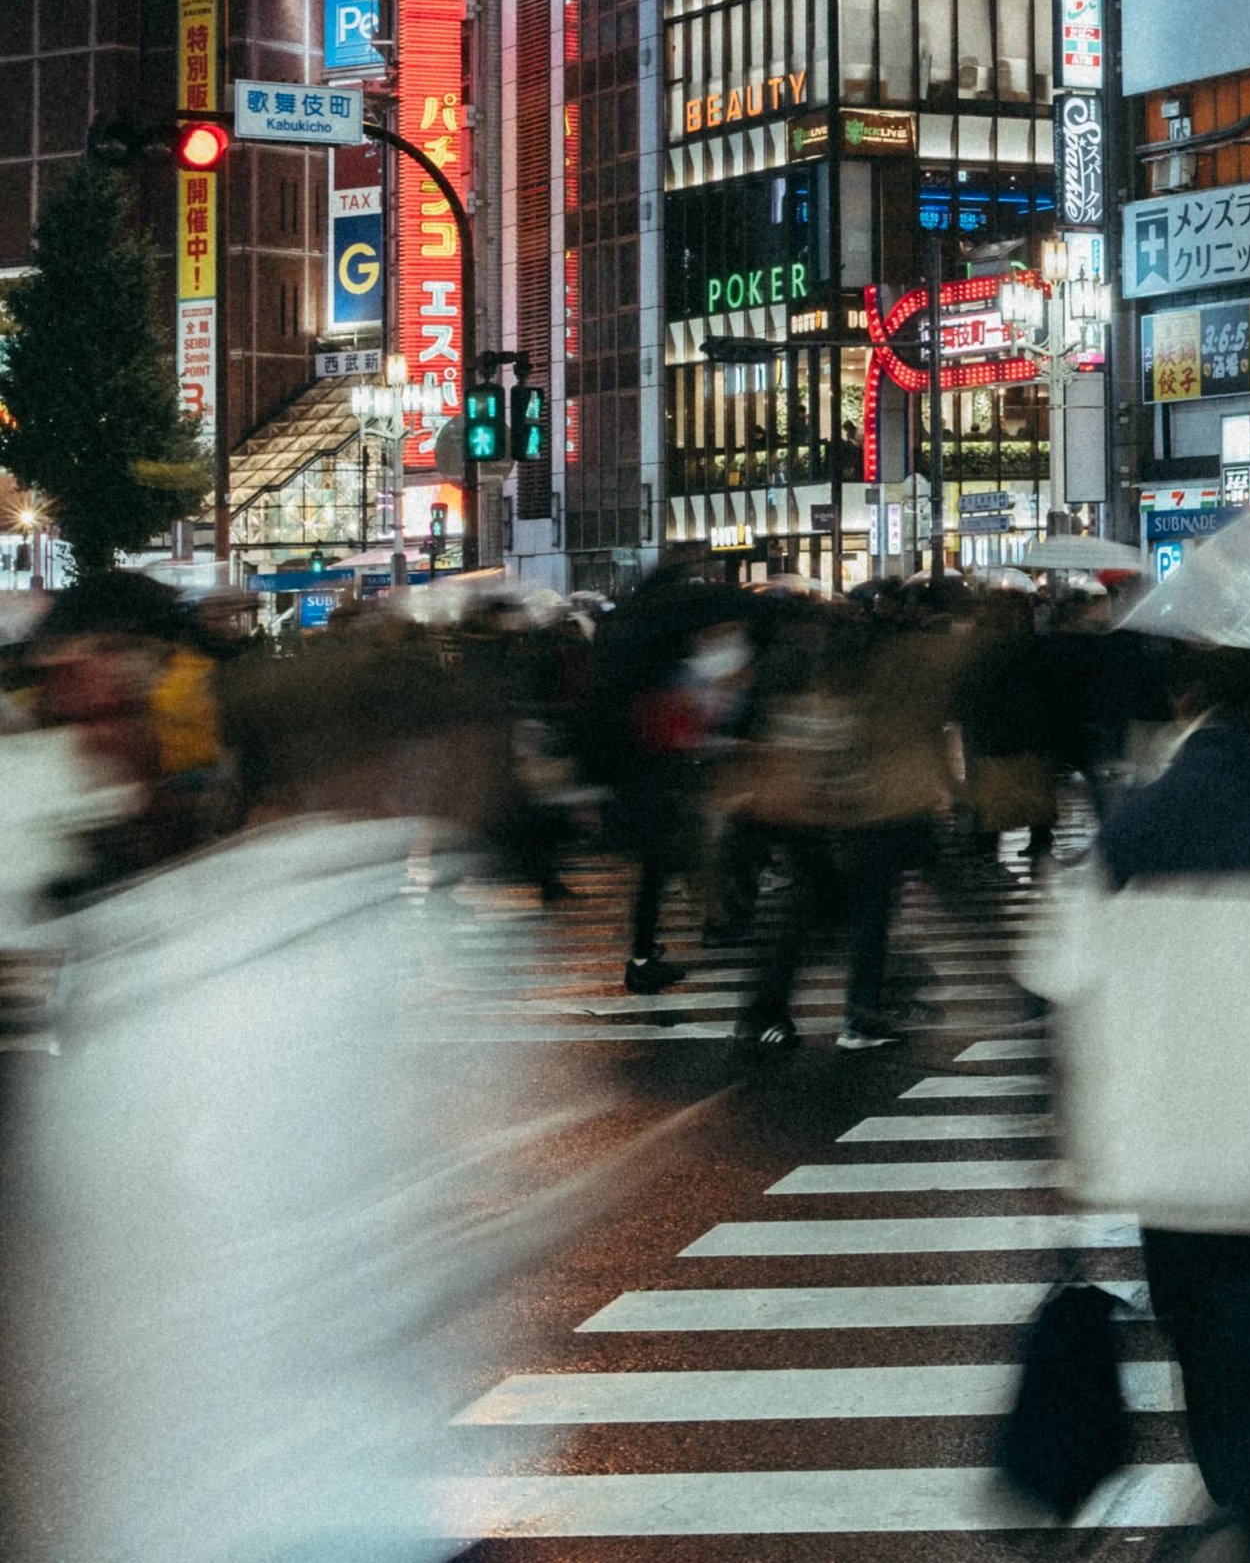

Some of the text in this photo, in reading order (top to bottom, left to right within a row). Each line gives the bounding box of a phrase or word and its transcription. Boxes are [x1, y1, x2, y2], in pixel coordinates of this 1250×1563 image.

[246, 90, 353, 120] 歌舞伎町
[686, 71, 806, 133] BEAUTY
[266, 117, 333, 135] Kabukicho
[419, 93, 458, 257] パチンコ
[1082, 145, 1102, 223] スパークル
[339, 194, 371, 212] TAX
[338, 242, 380, 295] G
[707, 263, 807, 313] POKER
[1157, 366, 1199, 398] 餃子
[1154, 513, 1217, 533] SUBNADE
